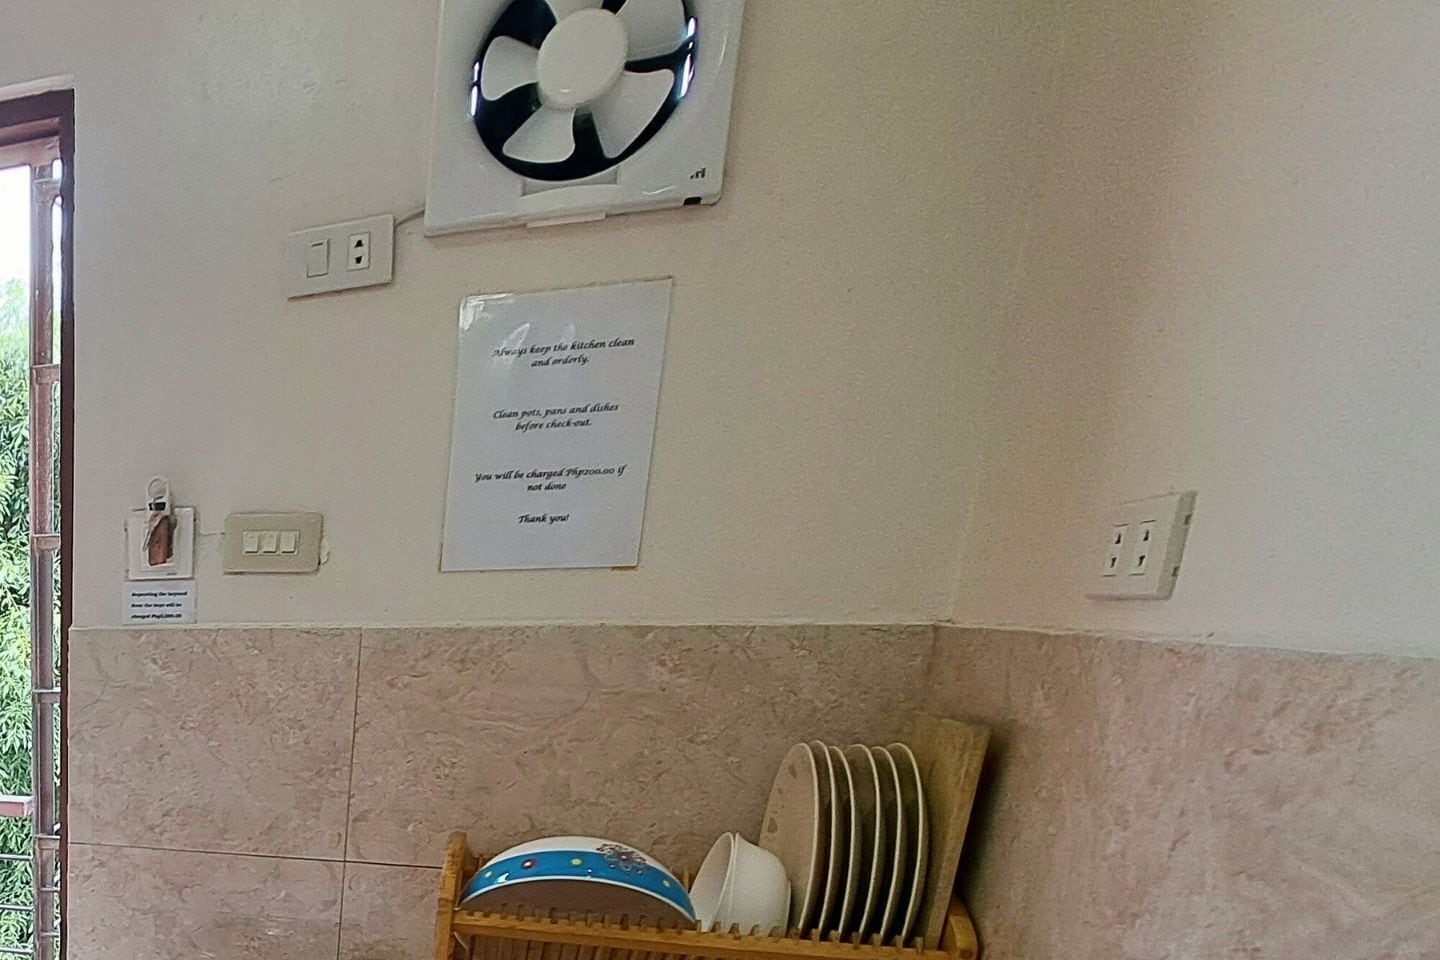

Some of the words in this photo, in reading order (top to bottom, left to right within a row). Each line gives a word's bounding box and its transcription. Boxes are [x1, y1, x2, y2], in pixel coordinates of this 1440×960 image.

[529, 344, 551, 355] keep
[553, 342, 568, 351] the
[570, 340, 606, 350] kitchen
[608, 338, 635, 347] clean
[531, 357, 549, 367] and
[551, 354, 589, 365] orderly.
[493, 410, 518, 419] Clean
[521, 408, 541, 419] pots,
[543, 407, 566, 418] pans
[569, 404, 590, 413] and
[590, 402, 619, 412] dishes
[515, 421, 543, 432] before
[546, 418, 592, 428] check-out.
[475, 473, 492, 483] You
[495, 470, 512, 480] will
[514, 470, 524, 479] be
[526, 468, 563, 480] charged
[617, 464, 628, 477] if
[527, 483, 542, 491] not
[544, 481, 567, 490] done
[518, 513, 547, 523] Thank
[549, 514, 570, 524] you!
